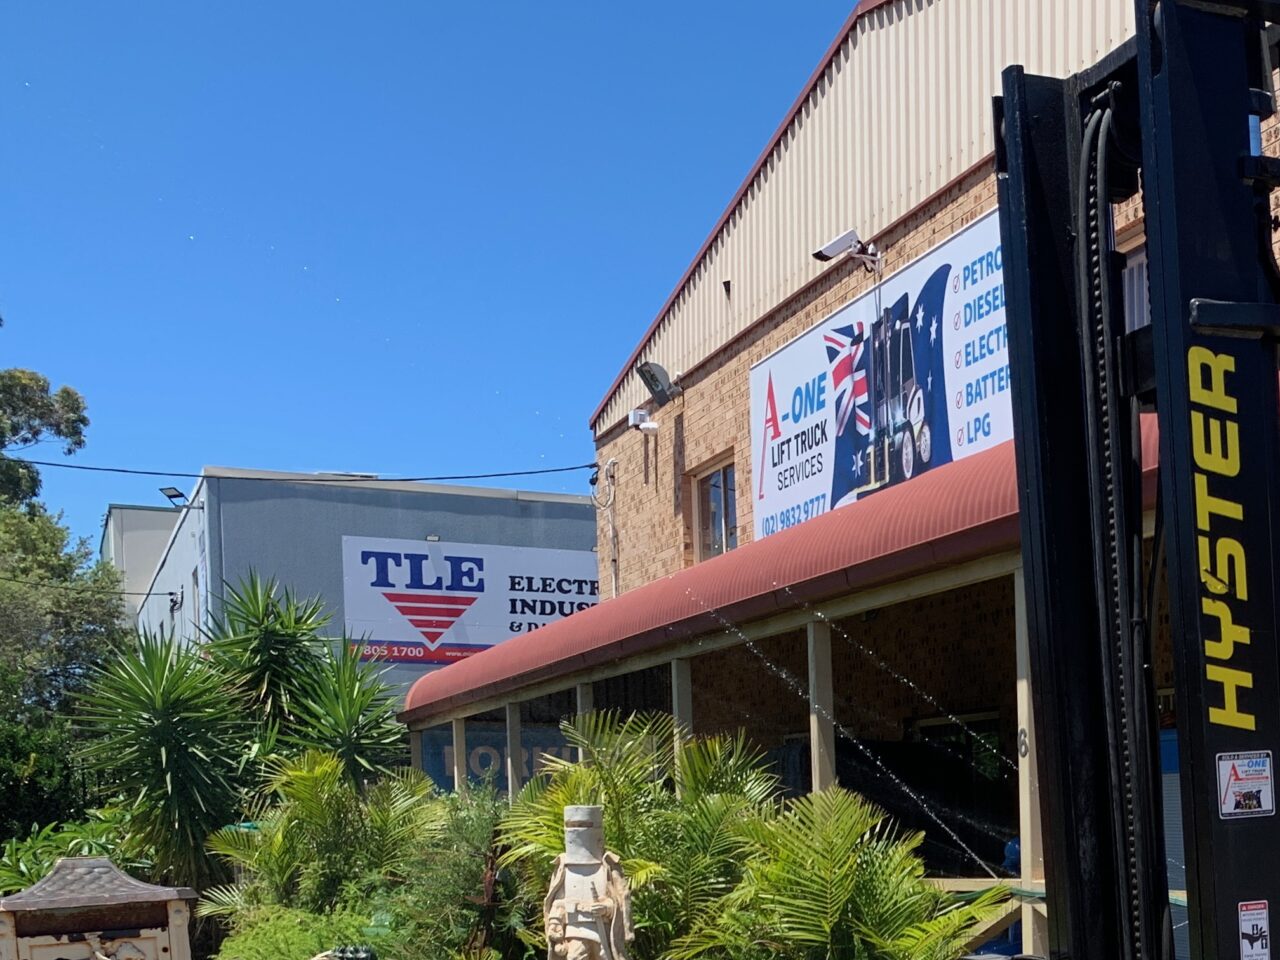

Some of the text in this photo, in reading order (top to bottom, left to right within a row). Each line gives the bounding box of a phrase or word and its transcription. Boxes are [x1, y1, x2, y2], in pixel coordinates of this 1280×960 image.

[772, 419, 828, 468] LIFT TRUCK
[967, 412, 991, 444] LPG
[777, 452, 823, 491] SERVICES
[780, 504, 801, 530] 9832
[804, 493, 827, 521] 9777
[1188, 345, 1256, 731] HYSTER
[361, 551, 484, 592] TLE
[509, 621, 523, 632] &
[392, 647, 424, 657] 1700
